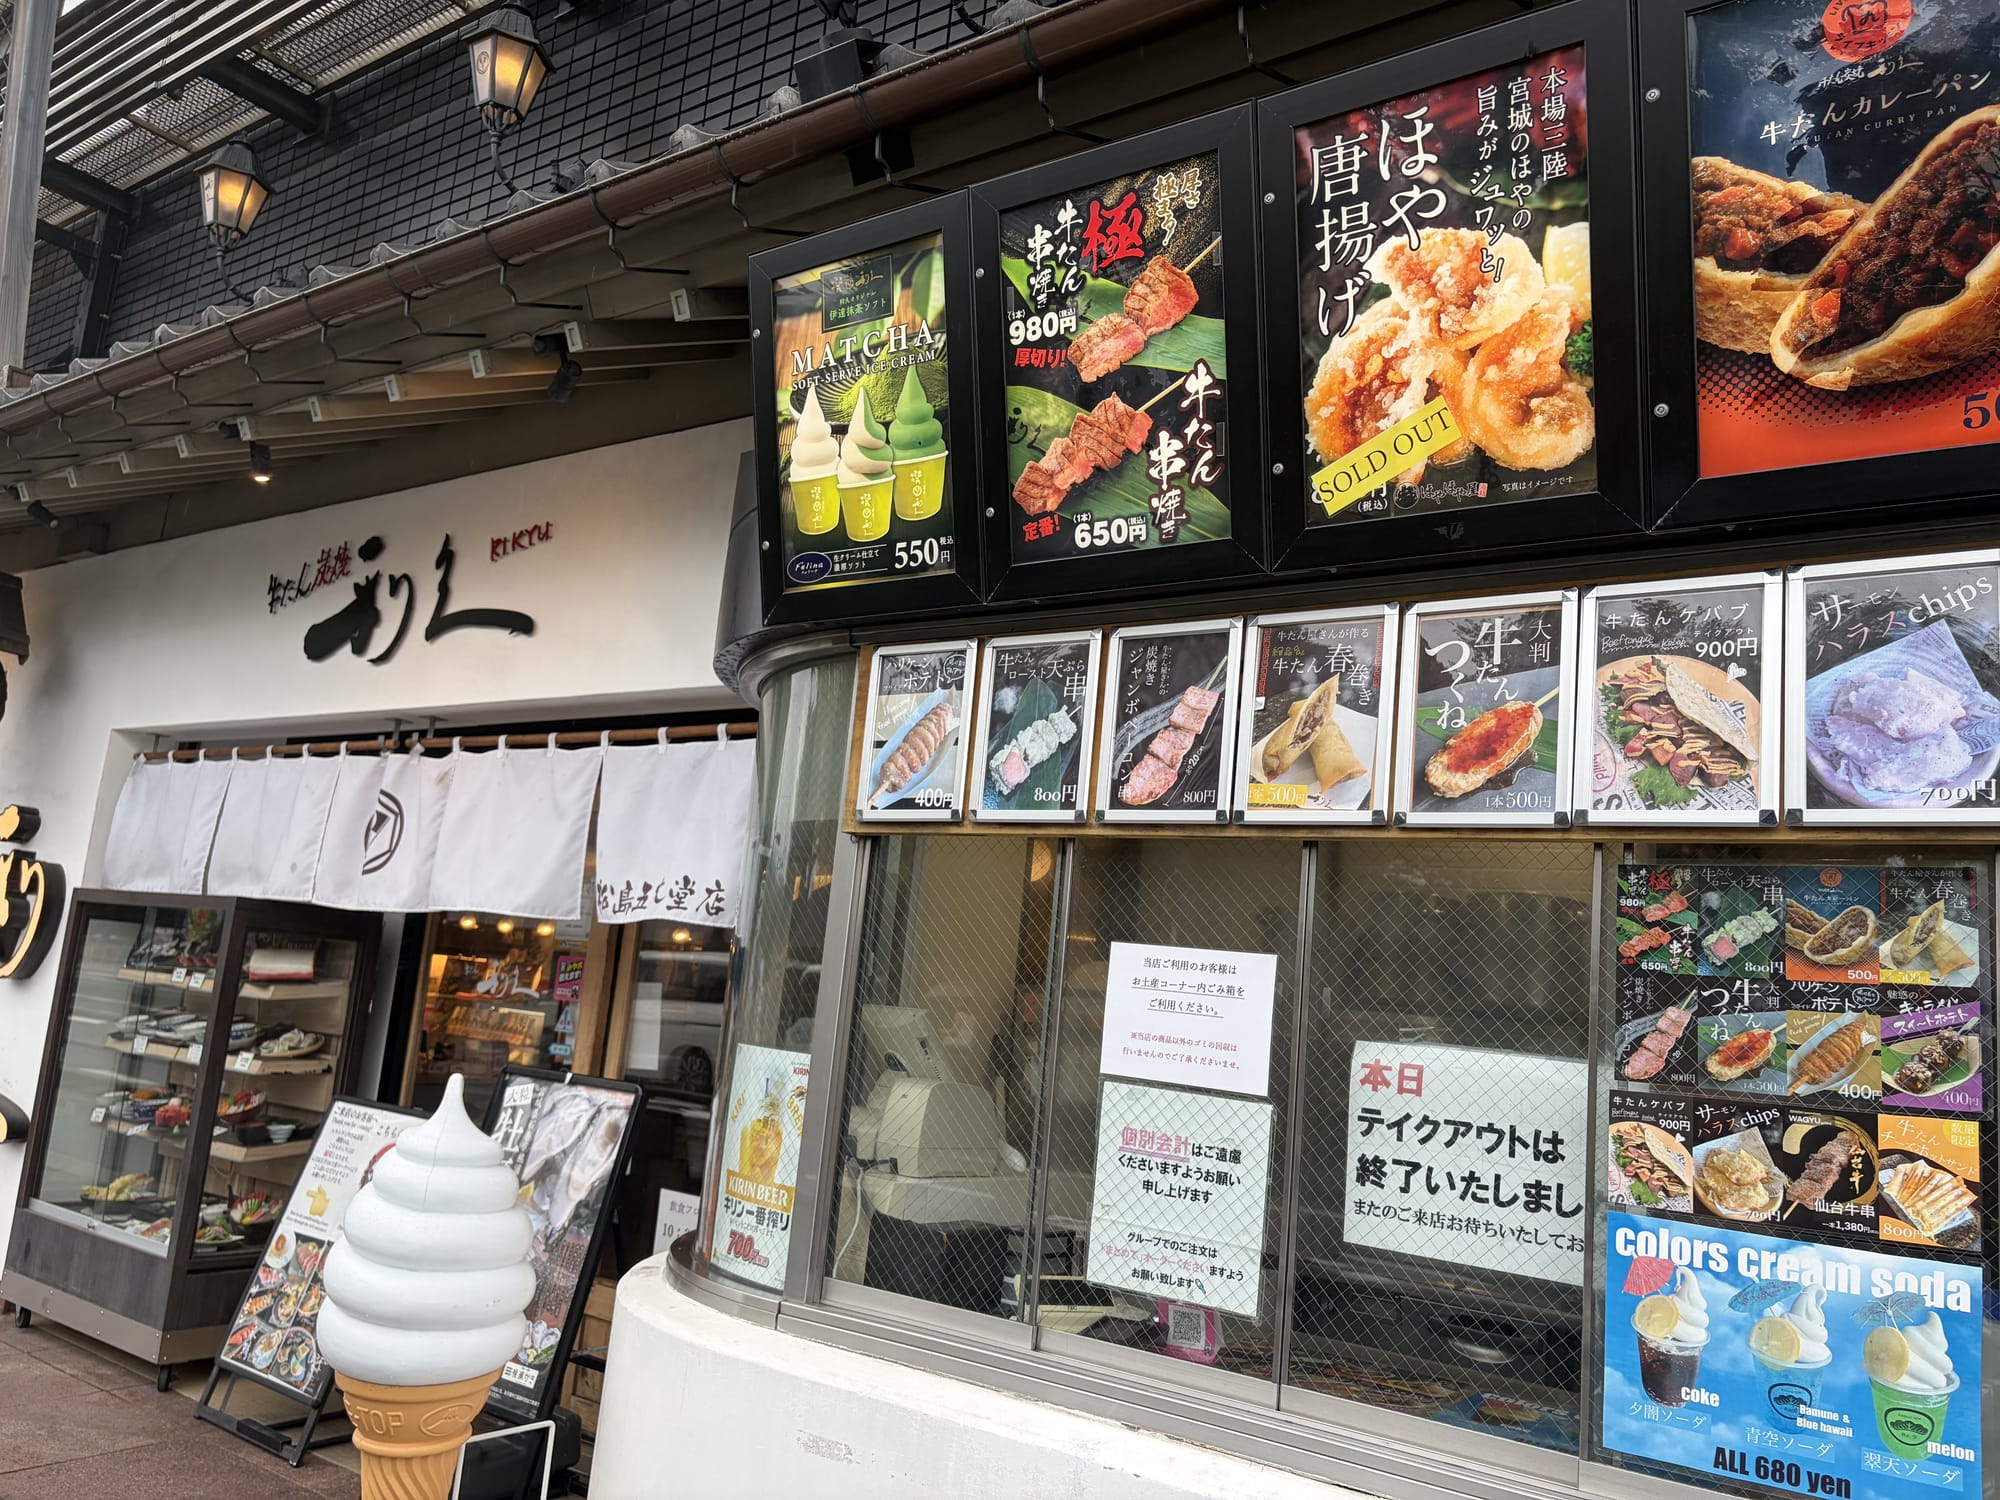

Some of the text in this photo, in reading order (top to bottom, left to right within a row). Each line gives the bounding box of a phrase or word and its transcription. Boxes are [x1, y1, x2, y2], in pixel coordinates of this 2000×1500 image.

[1760, 71, 1990, 146] 牛たんカレーパン
[1864, 113, 1916, 131] CURRY
[1926, 105, 1957, 118] PAN
[1540, 66, 1568, 182] 本場三陸
[1507, 76, 1533, 230] 宮城のほやの
[1377, 104, 1448, 251] ほや
[1054, 199, 1084, 293] 牛たん
[1310, 131, 1378, 339] 唐揚げ
[1026, 223, 1055, 309] 串焼き
[829, 298, 886, 320] 伊達抹茶ソフト
[1008, 312, 1077, 346] 980円
[790, 319, 936, 376] MATCHA
[792, 350, 936, 391] SOFT-SERVE ICE CREAM
[1183, 361, 1222, 486] 牛たん
[1963, 392, 2000, 429] 5
[1318, 448, 1388, 503] SOLD
[1396, 403, 1453, 457] OUT
[1148, 430, 1187, 540] 串焼き
[1502, 475, 1573, 492] 写真はイメージです
[490, 521, 553, 561] RIKYU
[1073, 518, 1147, 549] 650円
[1605, 603, 1750, 629] 牛たんケバブ
[1810, 586, 1899, 631] サーモン
[1815, 575, 1993, 661] ハラス chips
[1277, 627, 1369, 641] 牛たん屋さんが作る
[1528, 620, 1552, 664] 大判
[1694, 627, 1754, 637] テイクアウト
[1474, 618, 1522, 701] 牛たん
[1695, 637, 1758, 658] 900円
[886, 654, 936, 672] ハリケーン
[998, 652, 1033, 674] 牛たん
[1009, 669, 1046, 680] ロースト
[1145, 645, 1158, 686] 炭焼き
[1272, 657, 1323, 675] 牛たん
[1324, 643, 1373, 705] 春巻き
[904, 670, 944, 691] ポテト
[1063, 673, 1087, 702] 串
[1424, 639, 1472, 730] つくね
[1118, 647, 1143, 801] ジャンボベーコン串
[914, 788, 954, 808] 400円
[1034, 785, 1077, 803] 800円
[1183, 789, 1216, 803] 800円
[1485, 791, 1552, 809] 1本500円
[1920, 778, 1997, 806] 700円
[1701, 868, 1733, 882] 牛たん
[1620, 898, 1646, 907] 980円
[1763, 884, 1783, 905] 串
[1889, 886, 1930, 899] 牛たん
[1143, 957, 1237, 975] 当店ご利用のお客様は
[1641, 962, 1668, 971] 650円
[1745, 961, 1784, 974] 800円
[1847, 970, 1878, 981] 500円
[1132, 976, 1245, 997] お土産コーナー内ごみ箱を
[1766, 983, 1780, 1009] 大判
[1791, 981, 1840, 993] ハリケーン
[1886, 989, 1918, 1000] 魅惑の
[1149, 998, 1219, 1015] ご利用ください。
[1700, 988, 1730, 1041] つくね
[1731, 979, 1762, 1027] 牛たん
[1811, 996, 1855, 1012] ポテト
[1900, 997, 1959, 1016] キャラメル
[1131, 1031, 1237, 1052] ※当店の商品以外のゴミの回収は
[1122, 1046, 1240, 1070] 行いませんのでご了承くださいませ。
[1359, 1058, 1424, 1097] 本日
[1670, 1073, 1696, 1083] 800円
[1613, 1096, 1686, 1111] 牛たんケバブ
[1839, 1084, 1882, 1100] 400円
[1942, 1091, 1979, 1106] 400円
[1659, 1118, 1691, 1131] 900円
[1695, 1104, 1737, 1123] サーモン
[1697, 1107, 1780, 1137] ハラス chips
[1788, 1114, 1820, 1124] WAGYU
[1357, 1107, 1566, 1164] テイクアウトは
[1896, 1119, 1940, 1146] 牛たん
[1951, 1122, 1976, 1134] 数量
[1951, 1134, 1976, 1146] 限定
[1121, 1126, 1242, 1165] 個別会計はご遠慮
[1880, 1130, 1978, 1177] チーズホットサンド
[1118, 1153, 1241, 1187] くださいますようお願い
[729, 1175, 788, 1207] KIRIN BEER
[1142, 1179, 1213, 1205] 申し上げます
[1355, 1153, 1584, 1219] 終了いたしまし
[724, 1196, 790, 1231] キリン一番搾り
[1746, 1209, 1780, 1222] 700円
[1814, 1198, 1875, 1218] 仙台牛串
[1353, 1198, 1585, 1253] またのご来店お待ちいたしてお
[1883, 1223, 1924, 1239] 800円
[1127, 1231, 1218, 1259] グループでのご注文は
[1131, 1266, 1194, 1289] お願い致します
[1615, 1226, 1971, 1313] colors cream soda
[1681, 1386, 1720, 1408] coke
[1627, 1402, 1708, 1429] 夕闇ソーダ
[1796, 1418, 1853, 1438] Blue hawaii
[1842, 1415, 1850, 1423] &
[1745, 1426, 1834, 1458] 青空ソーダ
[1927, 1440, 1975, 1462] melon
[1713, 1446, 1851, 1499] ALL 680 yen
[1863, 1450, 1962, 1486] 翠天ソーダ
